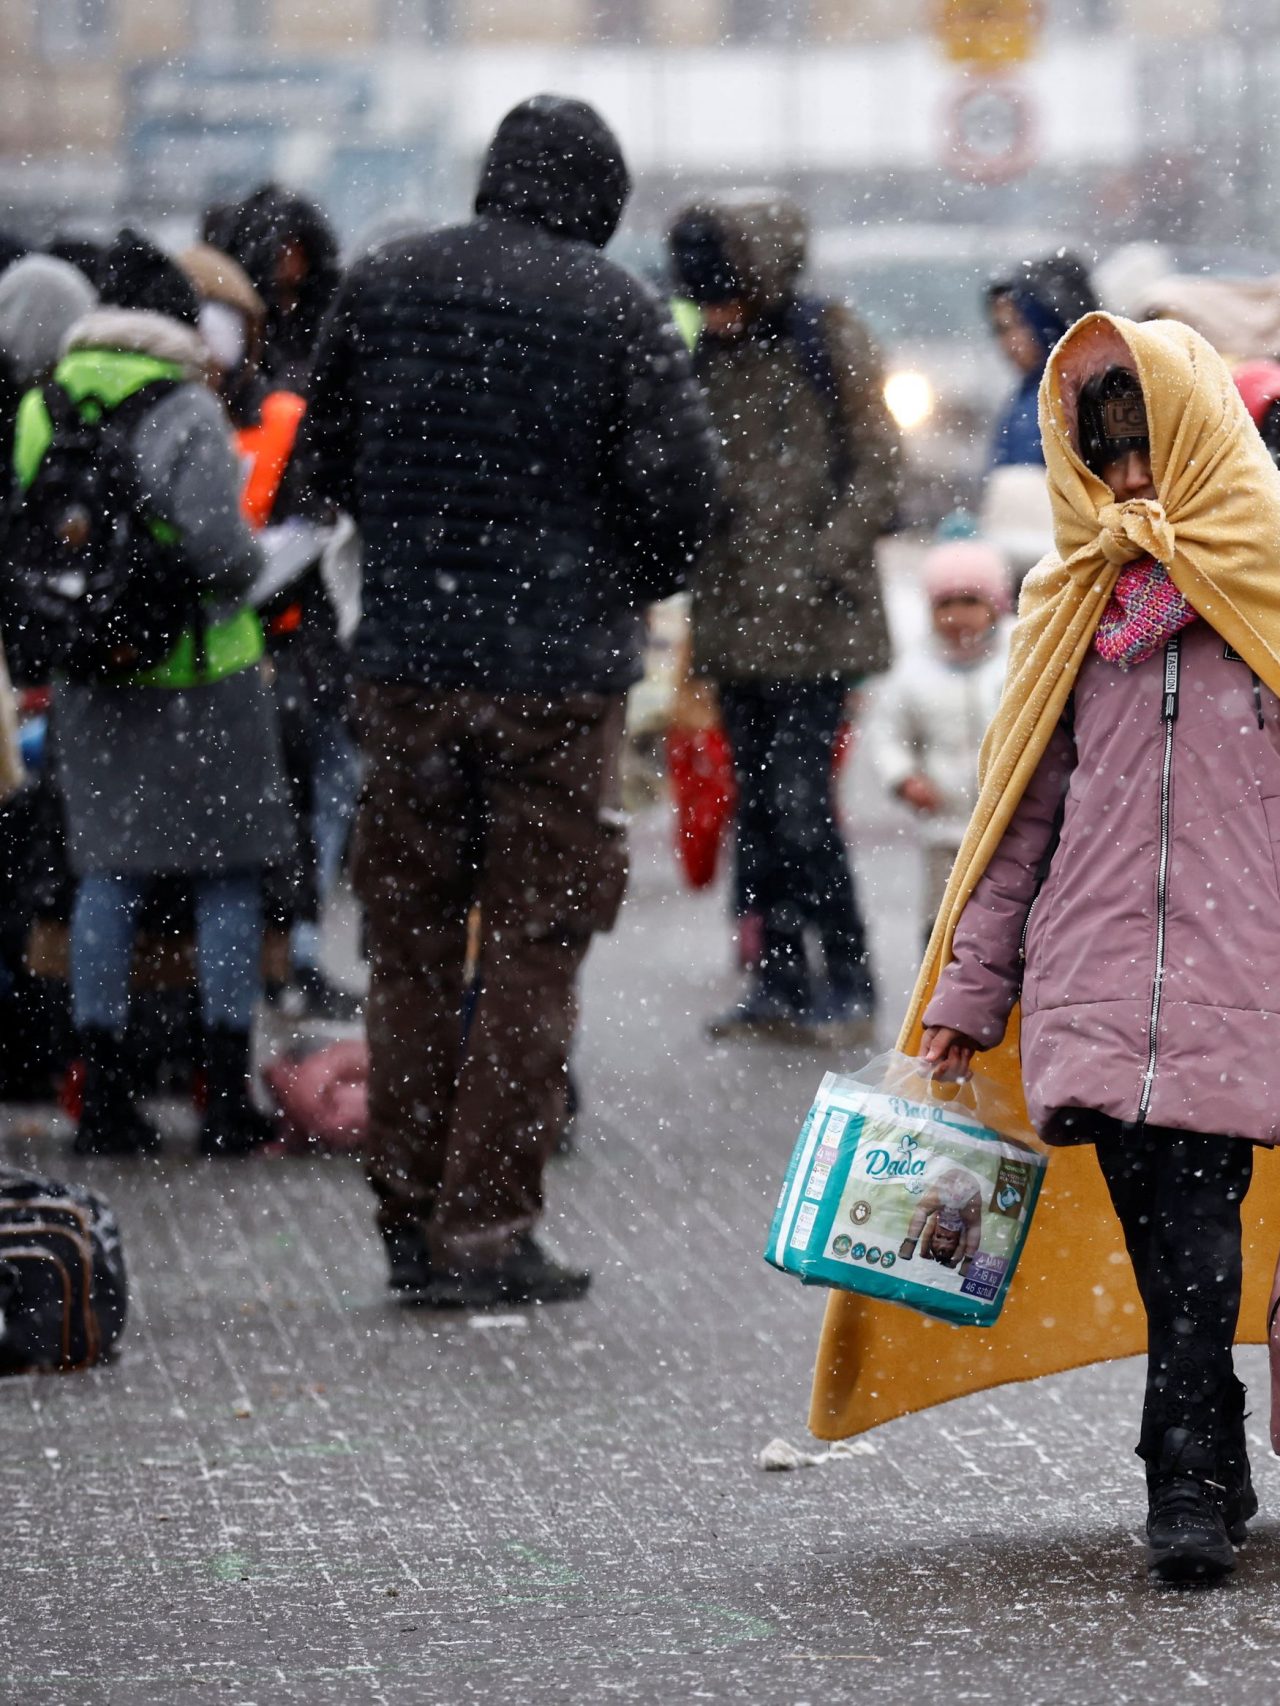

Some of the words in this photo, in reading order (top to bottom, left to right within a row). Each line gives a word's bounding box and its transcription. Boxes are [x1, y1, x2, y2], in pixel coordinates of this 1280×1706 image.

[1167, 655, 1177, 691] FASHION
[866, 1149, 926, 1177] Dada
[966, 1282, 977, 1293] 46
